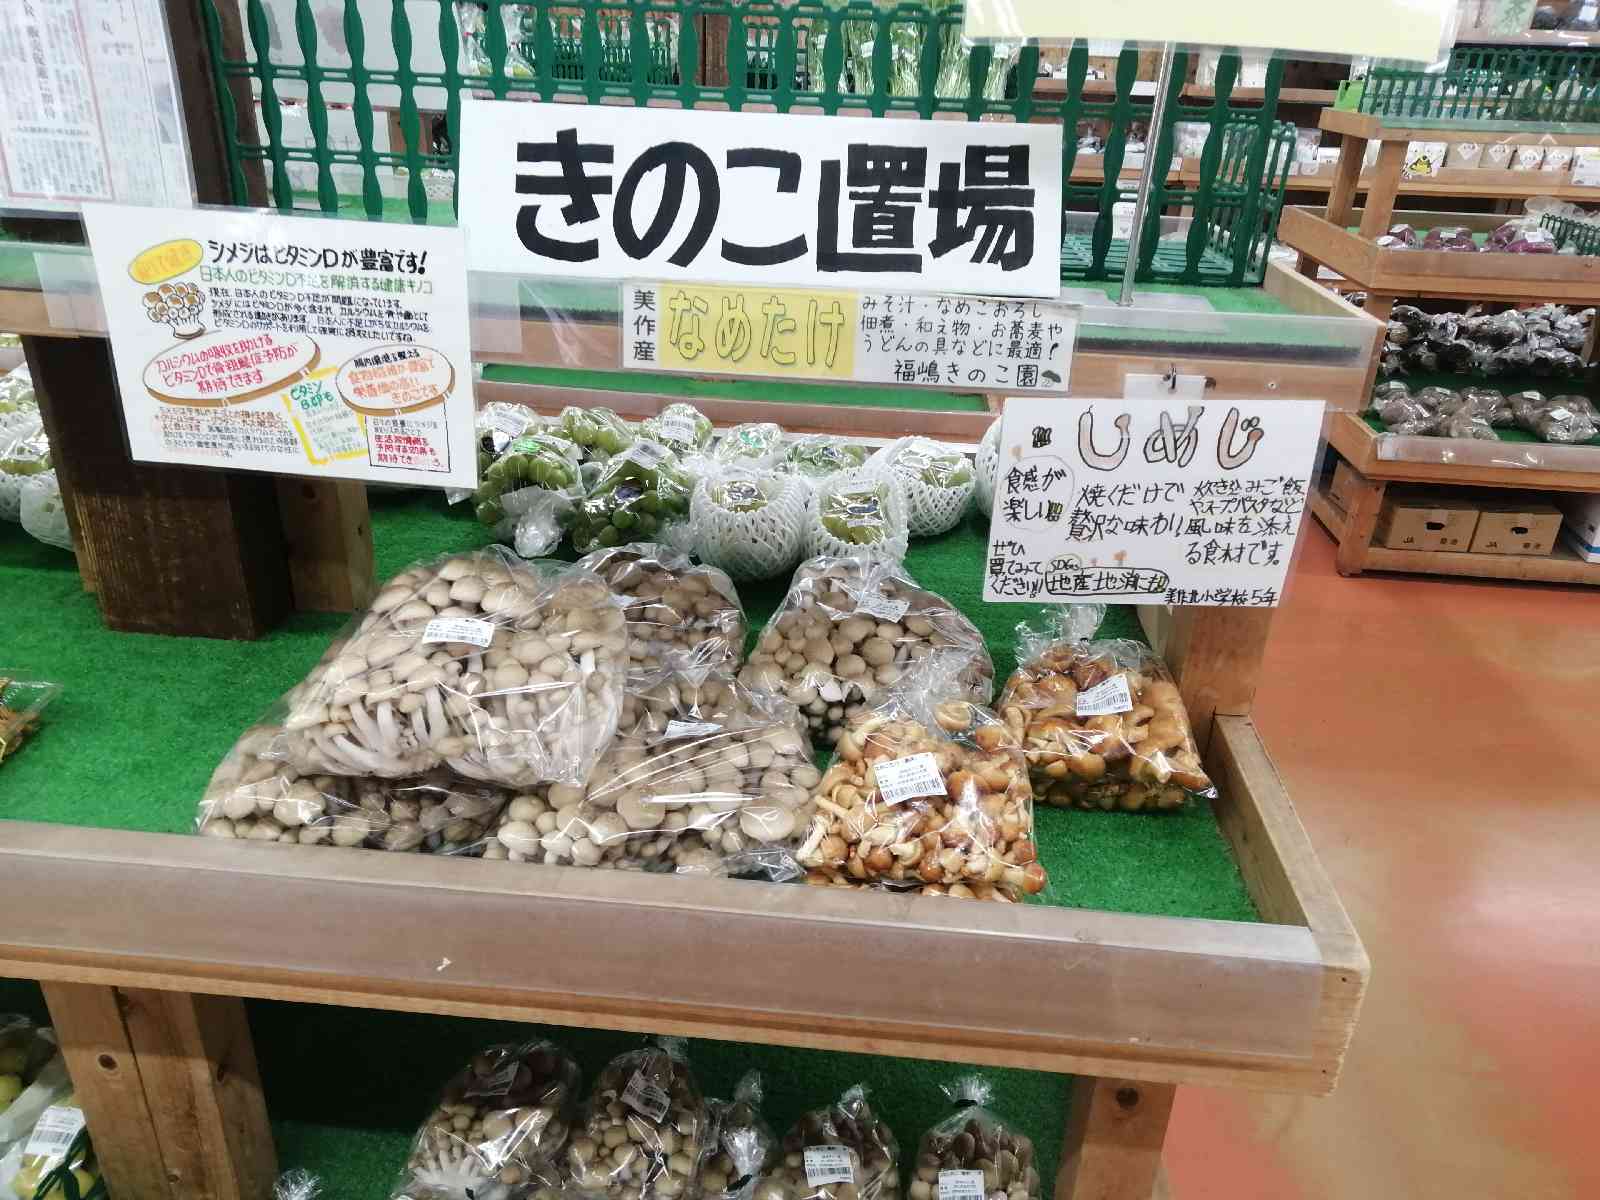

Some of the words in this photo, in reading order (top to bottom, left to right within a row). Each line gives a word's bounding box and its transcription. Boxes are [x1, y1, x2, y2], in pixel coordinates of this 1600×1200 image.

[514, 127, 1036, 273] きのこ置場
[207, 239, 428, 275] シメジはビタミンDが豊富です!
[861, 295, 1044, 319] みそ汁・なめこおろし
[632, 289, 656, 361] 美作産
[668, 289, 846, 368] なめたけ
[861, 315, 1064, 341] 佃煮・和え物・お蕎麦や
[863, 334, 1059, 361] うどんの具などに最適!
[893, 358, 1039, 388] 福嶋きのこ園
[1077, 404, 1265, 471] しめじ
[1006, 465, 1067, 495] 食感が
[1193, 475, 1307, 498] 炊き込みご飯
[1075, 482, 1185, 508] 焼くだけで
[1185, 515, 1296, 538] 風味を添え
[992, 540, 1026, 557] ぜひ
[1186, 538, 1285, 567] る食材です。
